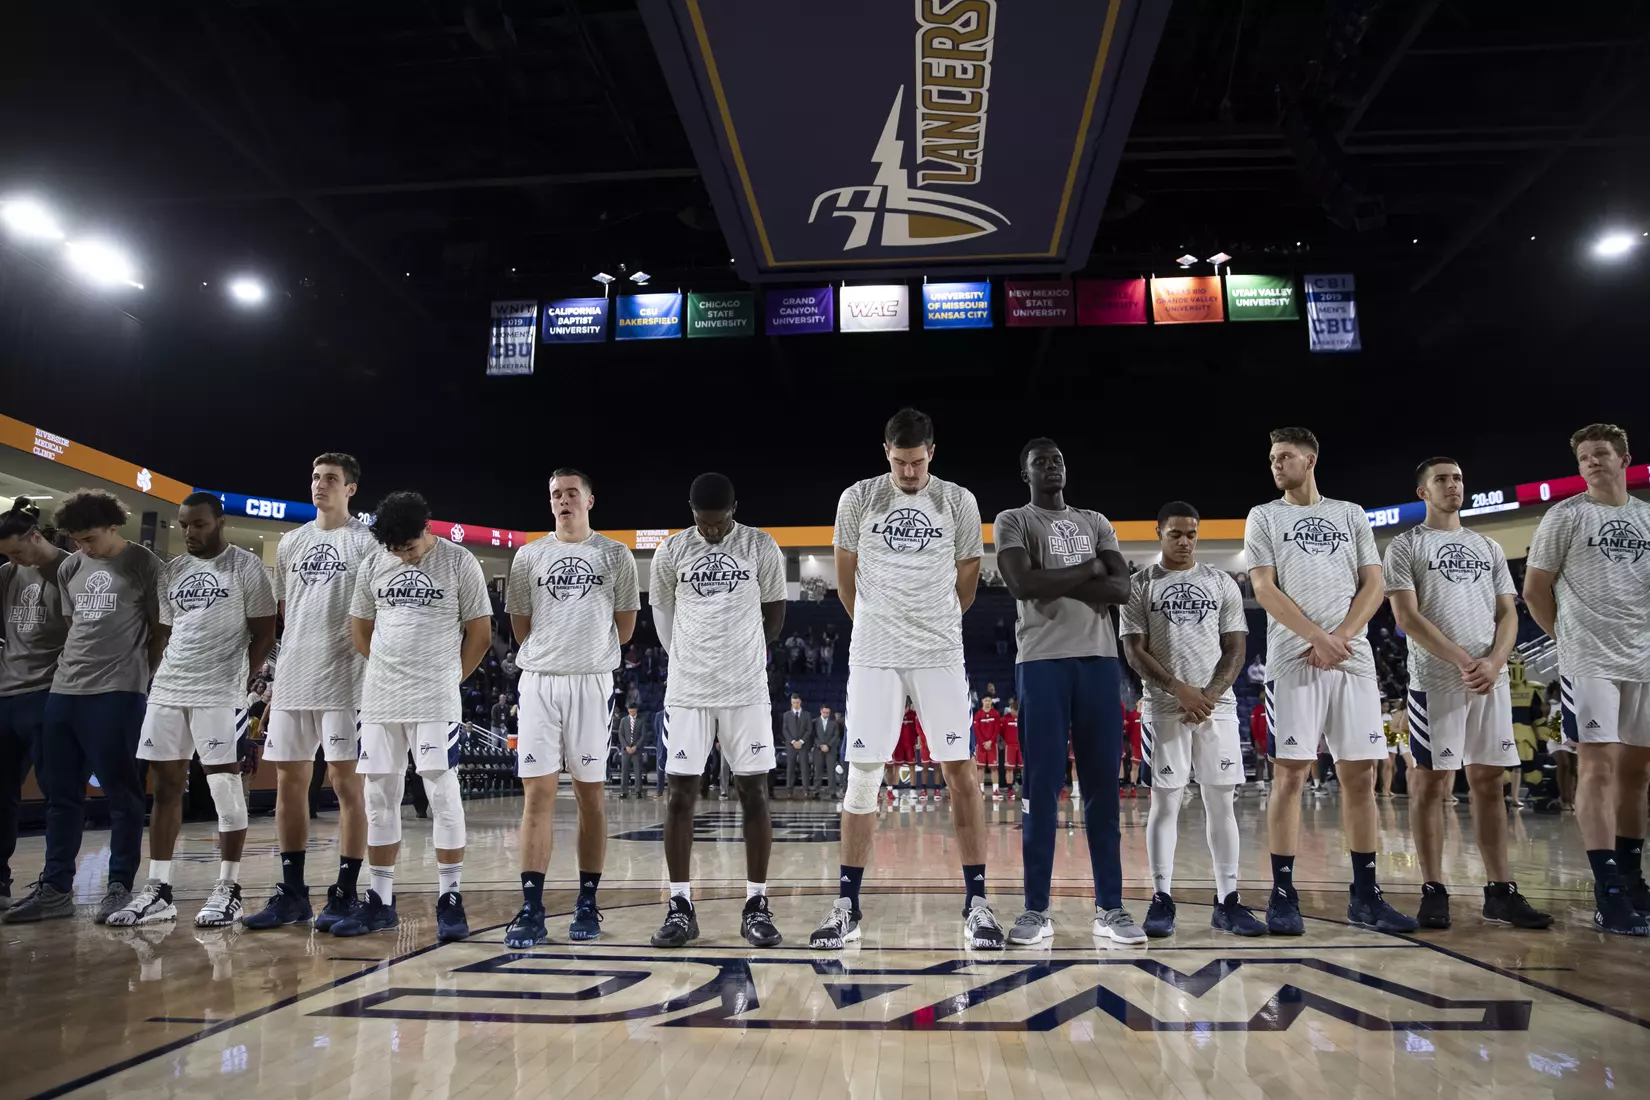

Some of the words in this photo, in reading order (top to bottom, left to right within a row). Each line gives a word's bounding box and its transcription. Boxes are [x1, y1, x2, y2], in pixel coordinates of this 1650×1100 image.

[915, 0, 997, 187] LANCERS
[1313, 278, 1347, 289] CBI
[930, 291, 985, 301] UNIVERSITY
[1009, 290, 1030, 298] NEW
[1032, 289, 1070, 297] MEXICO
[1231, 288, 1257, 298] UTAH
[1258, 288, 1293, 297] VALLEY
[1320, 293, 1342, 301] 2019
[699, 300, 740, 309] CHICAGO
[782, 297, 816, 305] GRAND
[927, 302, 940, 310] OF
[942, 301, 988, 310] MISSOURI
[1025, 299, 1053, 307] STATE
[1235, 298, 1291, 307] UNIVERSITY
[548, 307, 602, 316] CALIFORNIA
[640, 308, 658, 316] CSU
[779, 306, 818, 315] CANYON
[848, 300, 899, 318] WAC
[1013, 309, 1067, 317] UNIVERSITY
[1164, 304, 1211, 312] UNIVERSITY
[707, 310, 734, 318] STATE
[928, 311, 966, 320] KANSAS
[967, 310, 988, 319] CITY
[503, 318, 523, 326] 2019
[557, 316, 594, 325] BAPTIST
[619, 317, 679, 326] BAKERSFIELD
[695, 319, 747, 328] UNIVERSITY
[772, 315, 826, 325] UNIVERSITY
[549, 326, 601, 335] UNIVERSITY
[1313, 318, 1355, 334] CBU
[492, 343, 532, 358] CBU
[1539, 483, 1550, 501] 0
[1471, 490, 1504, 508] 20:00
[246, 498, 287, 519] CBU
[1365, 508, 1400, 528] CBU
[871, 523, 943, 538] LANCERS
[1283, 532, 1349, 542] LANCERS
[1063, 554, 1082, 564] CBU
[291, 561, 347, 572] LANCERS
[1428, 560, 1491, 571] LANCERS
[537, 574, 604, 587] LANCERS
[681, 570, 750, 582] LANCERS
[170, 588, 229, 600] LANCERS
[378, 588, 444, 599] LANCERS
[1151, 600, 1217, 612] LANCERS
[82, 611, 103, 619] CBU
[17, 623, 34, 631] CBU
[304, 952, 1533, 1031] WAC
